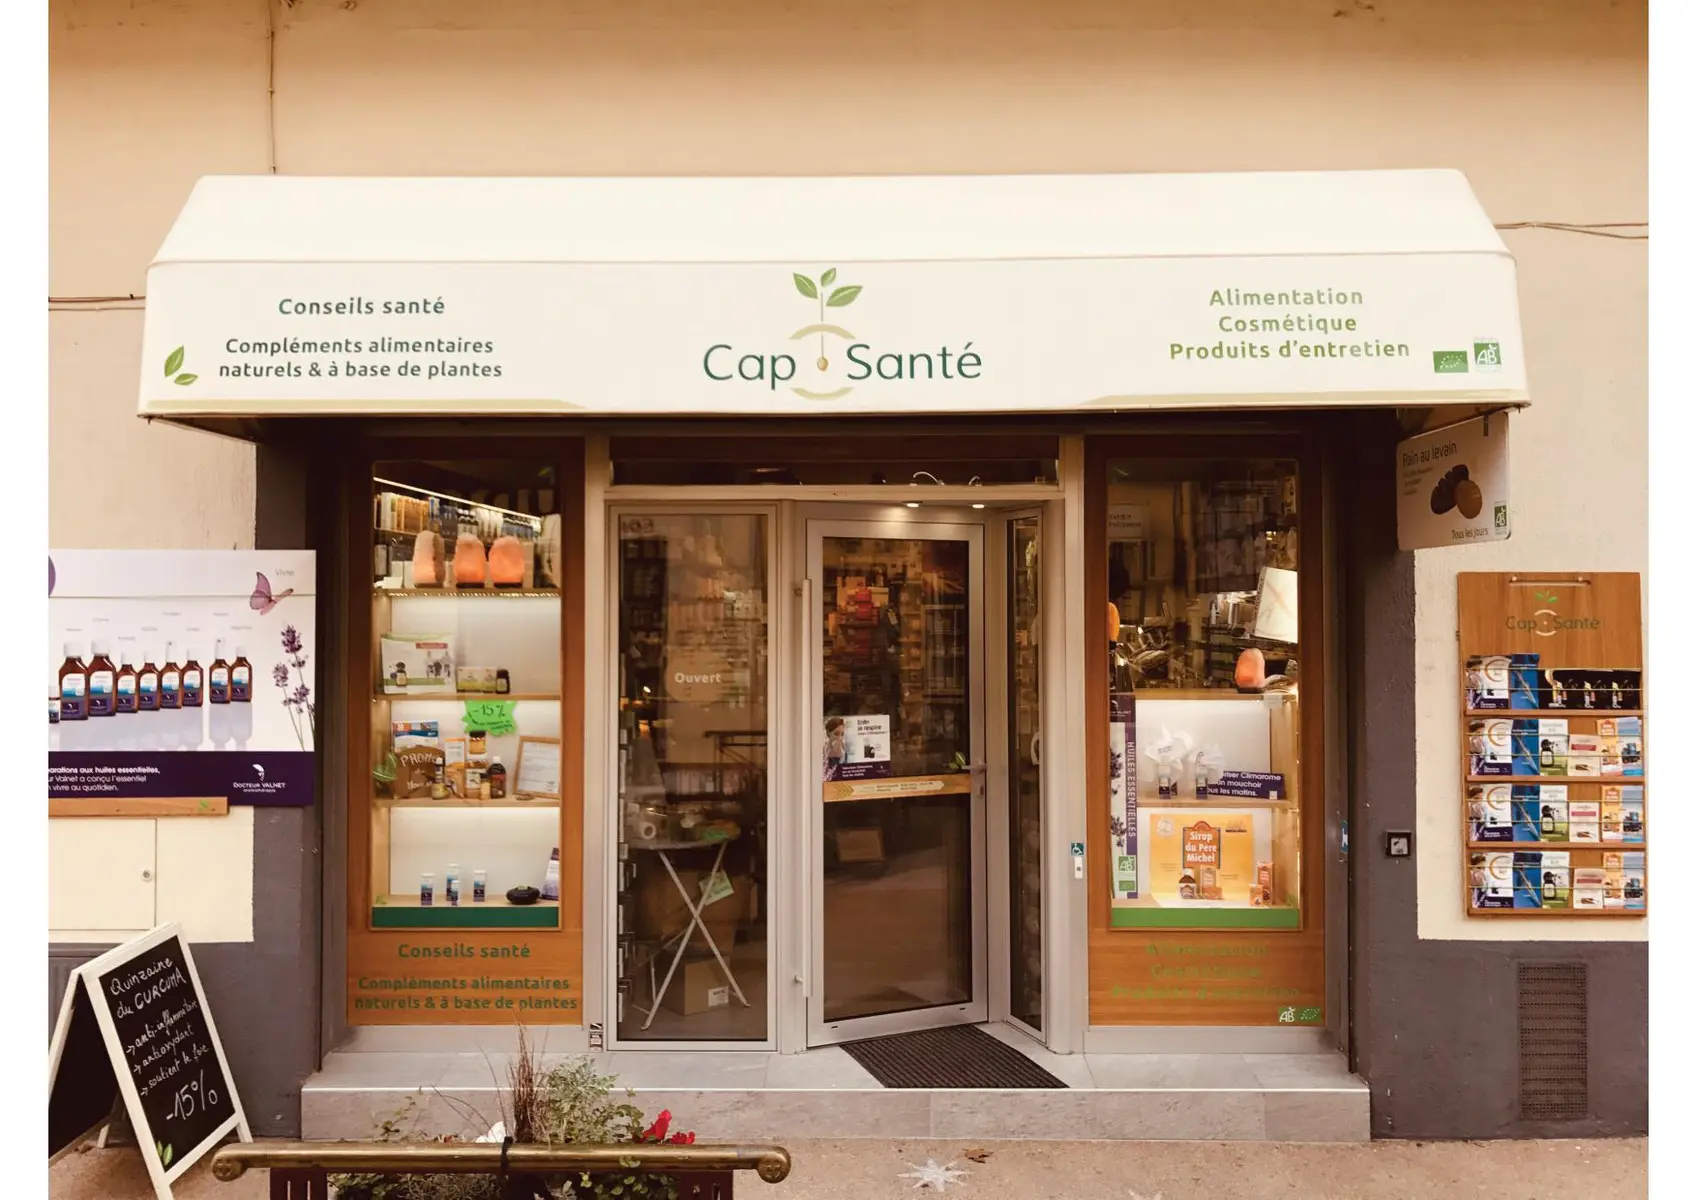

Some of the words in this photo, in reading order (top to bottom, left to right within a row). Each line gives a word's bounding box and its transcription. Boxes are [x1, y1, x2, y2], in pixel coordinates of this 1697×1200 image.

[278, 298, 374, 315] Conseils
[383, 296, 445, 315] santé
[1209, 288, 1363, 306] Alimentation
[1218, 314, 1357, 335] Cosmétique
[226, 336, 363, 357] Compléments
[368, 336, 493, 354] alimentaires
[1170, 341, 1270, 359] Produits
[219, 361, 302, 378] naturels
[309, 362, 322, 377] &
[328, 360, 339, 377] à
[346, 361, 391, 377] base
[397, 361, 421, 377] de
[428, 361, 502, 381] plantes
[703, 344, 796, 391] Cap
[846, 341, 982, 380] Santé
[1403, 451, 1418, 466] Pain
[1420, 449, 1430, 463] au
[1432, 441, 1457, 459] levain
[1505, 616, 1537, 632] Cap
[1553, 615, 1600, 630] Santé
[674, 672, 721, 683] Ouvert
[1127, 741, 1135, 774] HUILES
[117, 766, 160, 774] essentielles,
[1240, 772, 1282, 781] Climarome
[1227, 780, 1262, 788] mouchoir
[1127, 776, 1137, 837] ESSENTIELLES
[1190, 831, 1213, 844] Sirop
[1185, 842, 1197, 852] du
[1187, 852, 1215, 863] Michel
[398, 943, 475, 958] Conseils
[480, 942, 531, 958] santé
[111, 957, 173, 995] Quinzaine
[358, 976, 467, 992] Compléments
[471, 976, 570, 990] alimentaires
[116, 1001, 133, 1019] du
[135, 968, 187, 1010] CURCUMA
[354, 996, 420, 1010] naturels
[424, 996, 436, 1010] &
[440, 995, 449, 1010] à
[454, 996, 490, 1010] base
[495, 996, 514, 1010] de
[519, 996, 578, 1012] plantes
[1279, 1009, 1295, 1023] AB
[149, 1057, 180, 1089] soutient
[166, 1069, 218, 1121] -15%
